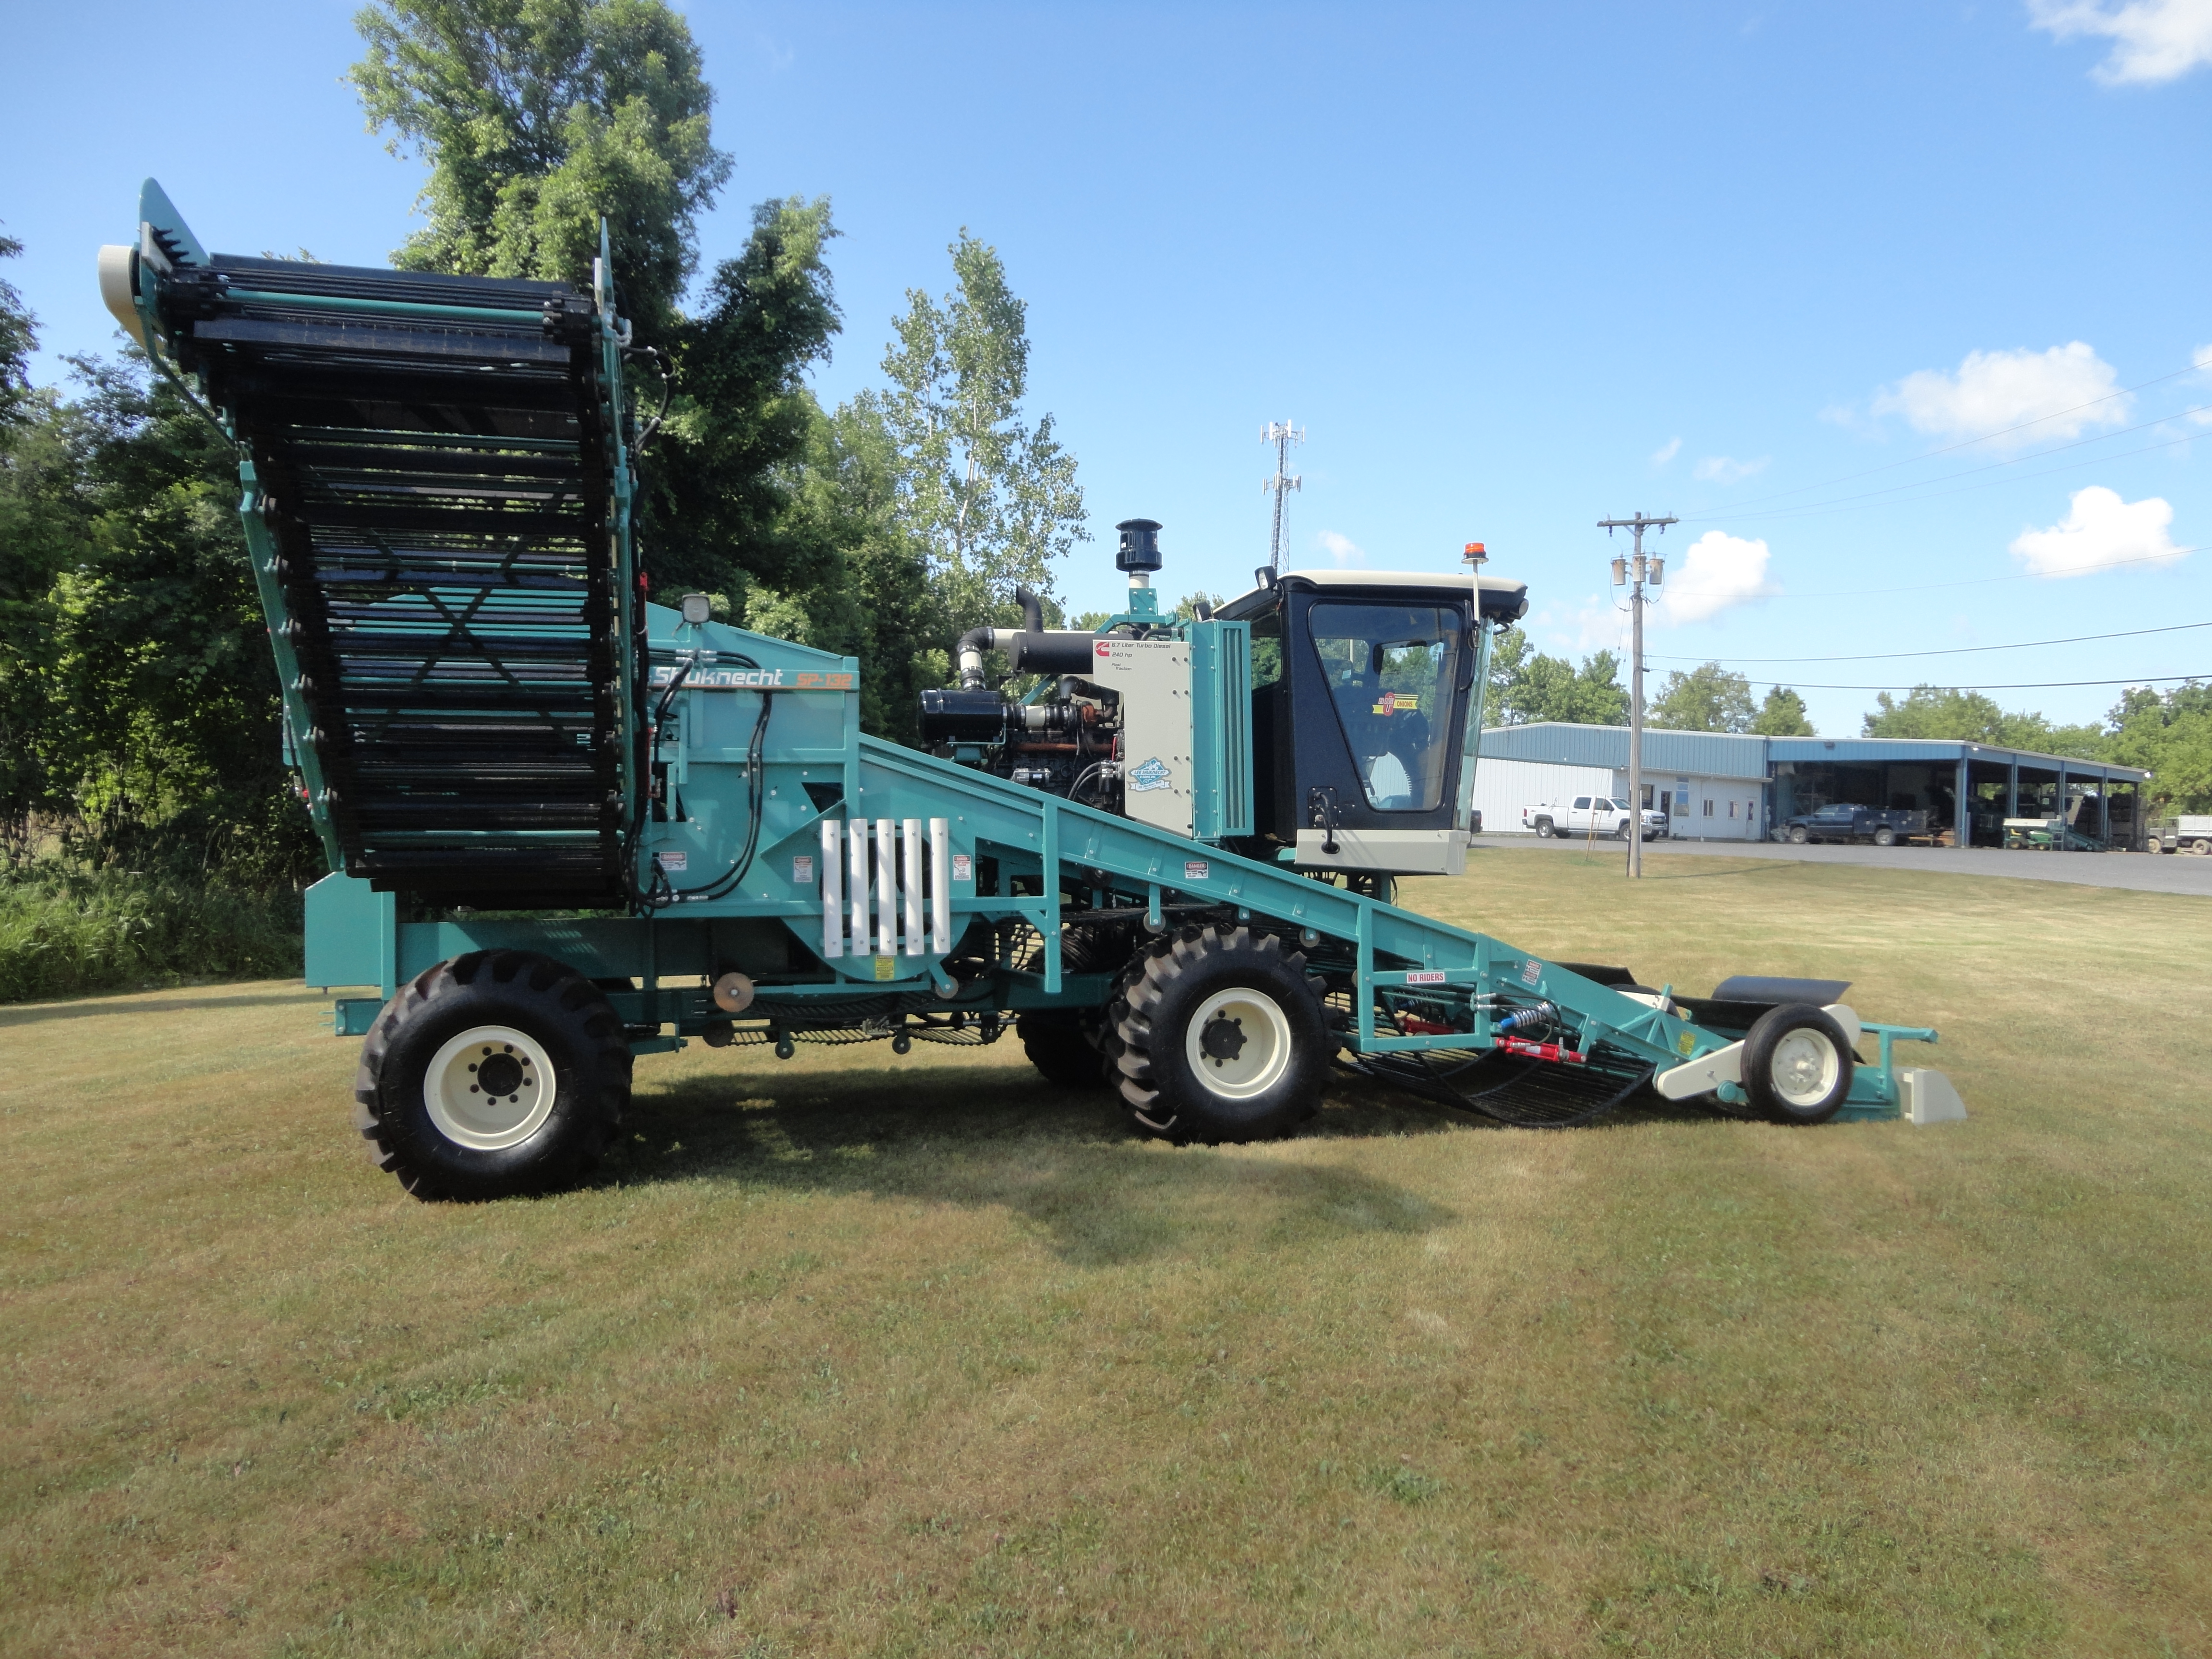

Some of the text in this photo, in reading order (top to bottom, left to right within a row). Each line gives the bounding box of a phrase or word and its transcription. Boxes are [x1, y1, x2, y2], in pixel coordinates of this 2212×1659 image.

[796, 673, 853, 686] SP-132
[1408, 973, 1443, 982] NO RIDERS
